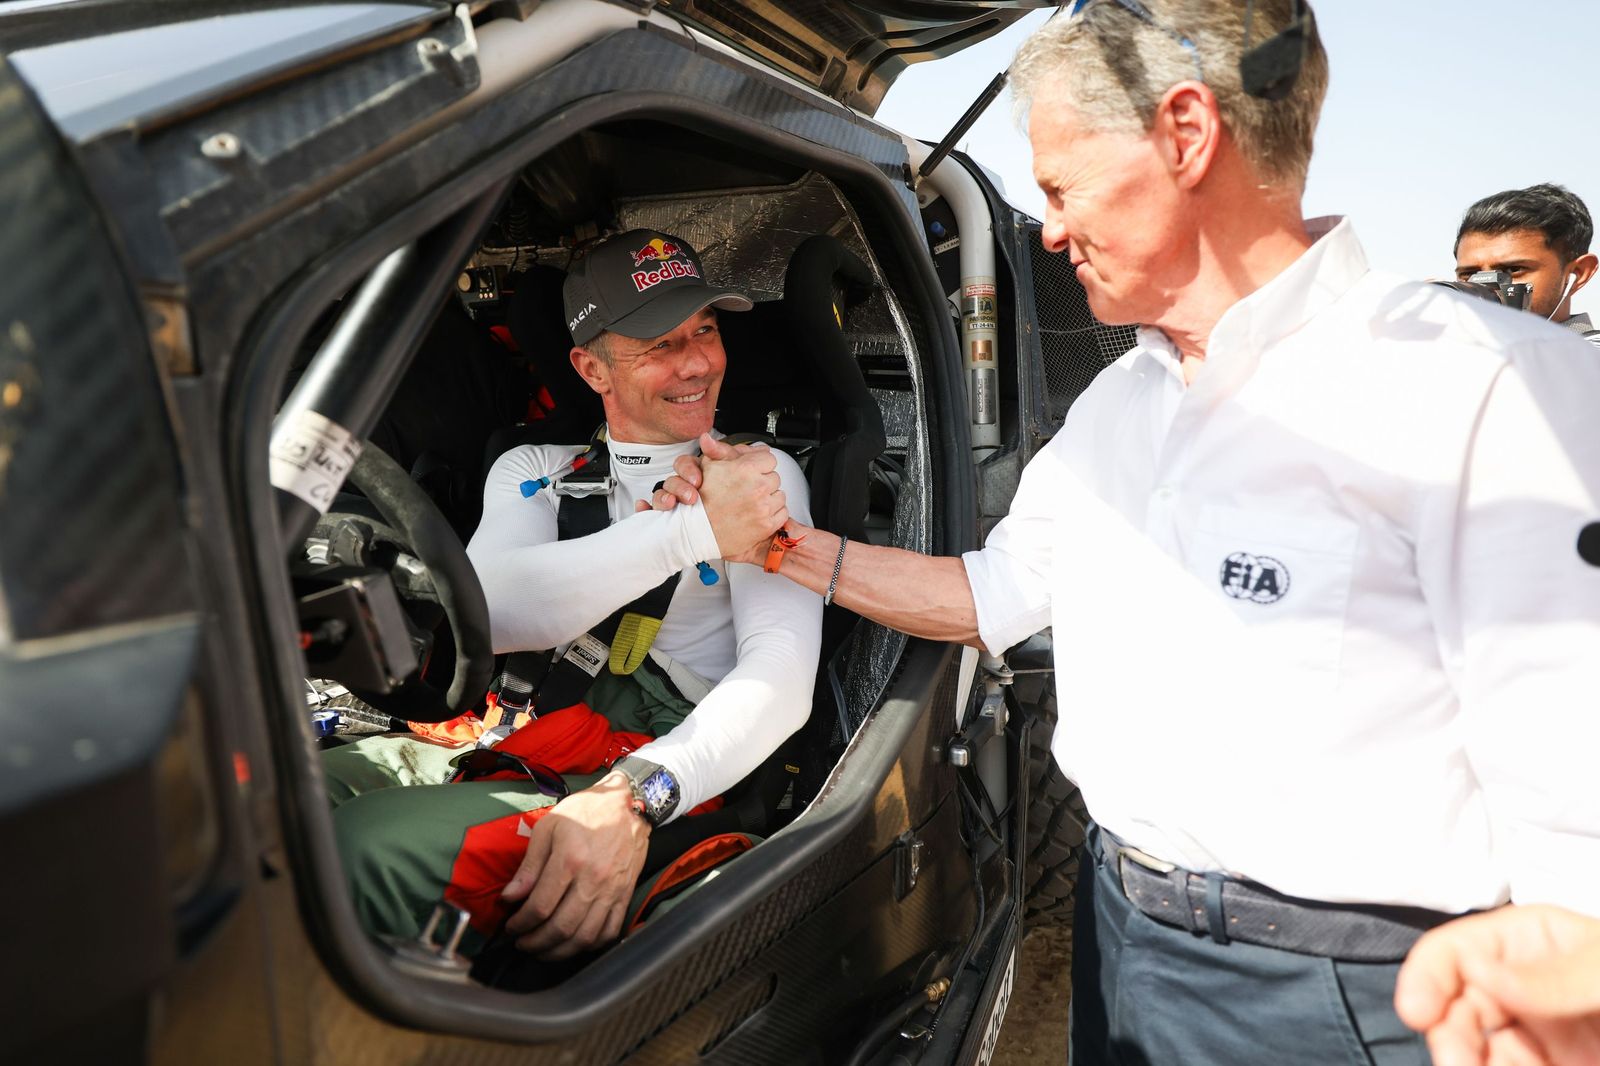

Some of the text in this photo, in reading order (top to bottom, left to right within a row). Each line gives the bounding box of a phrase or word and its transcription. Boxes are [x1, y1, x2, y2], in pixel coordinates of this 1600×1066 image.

[632, 259, 700, 292] Red Bull
[569, 302, 597, 331] DACIA
[616, 454, 647, 464] Sabelt
